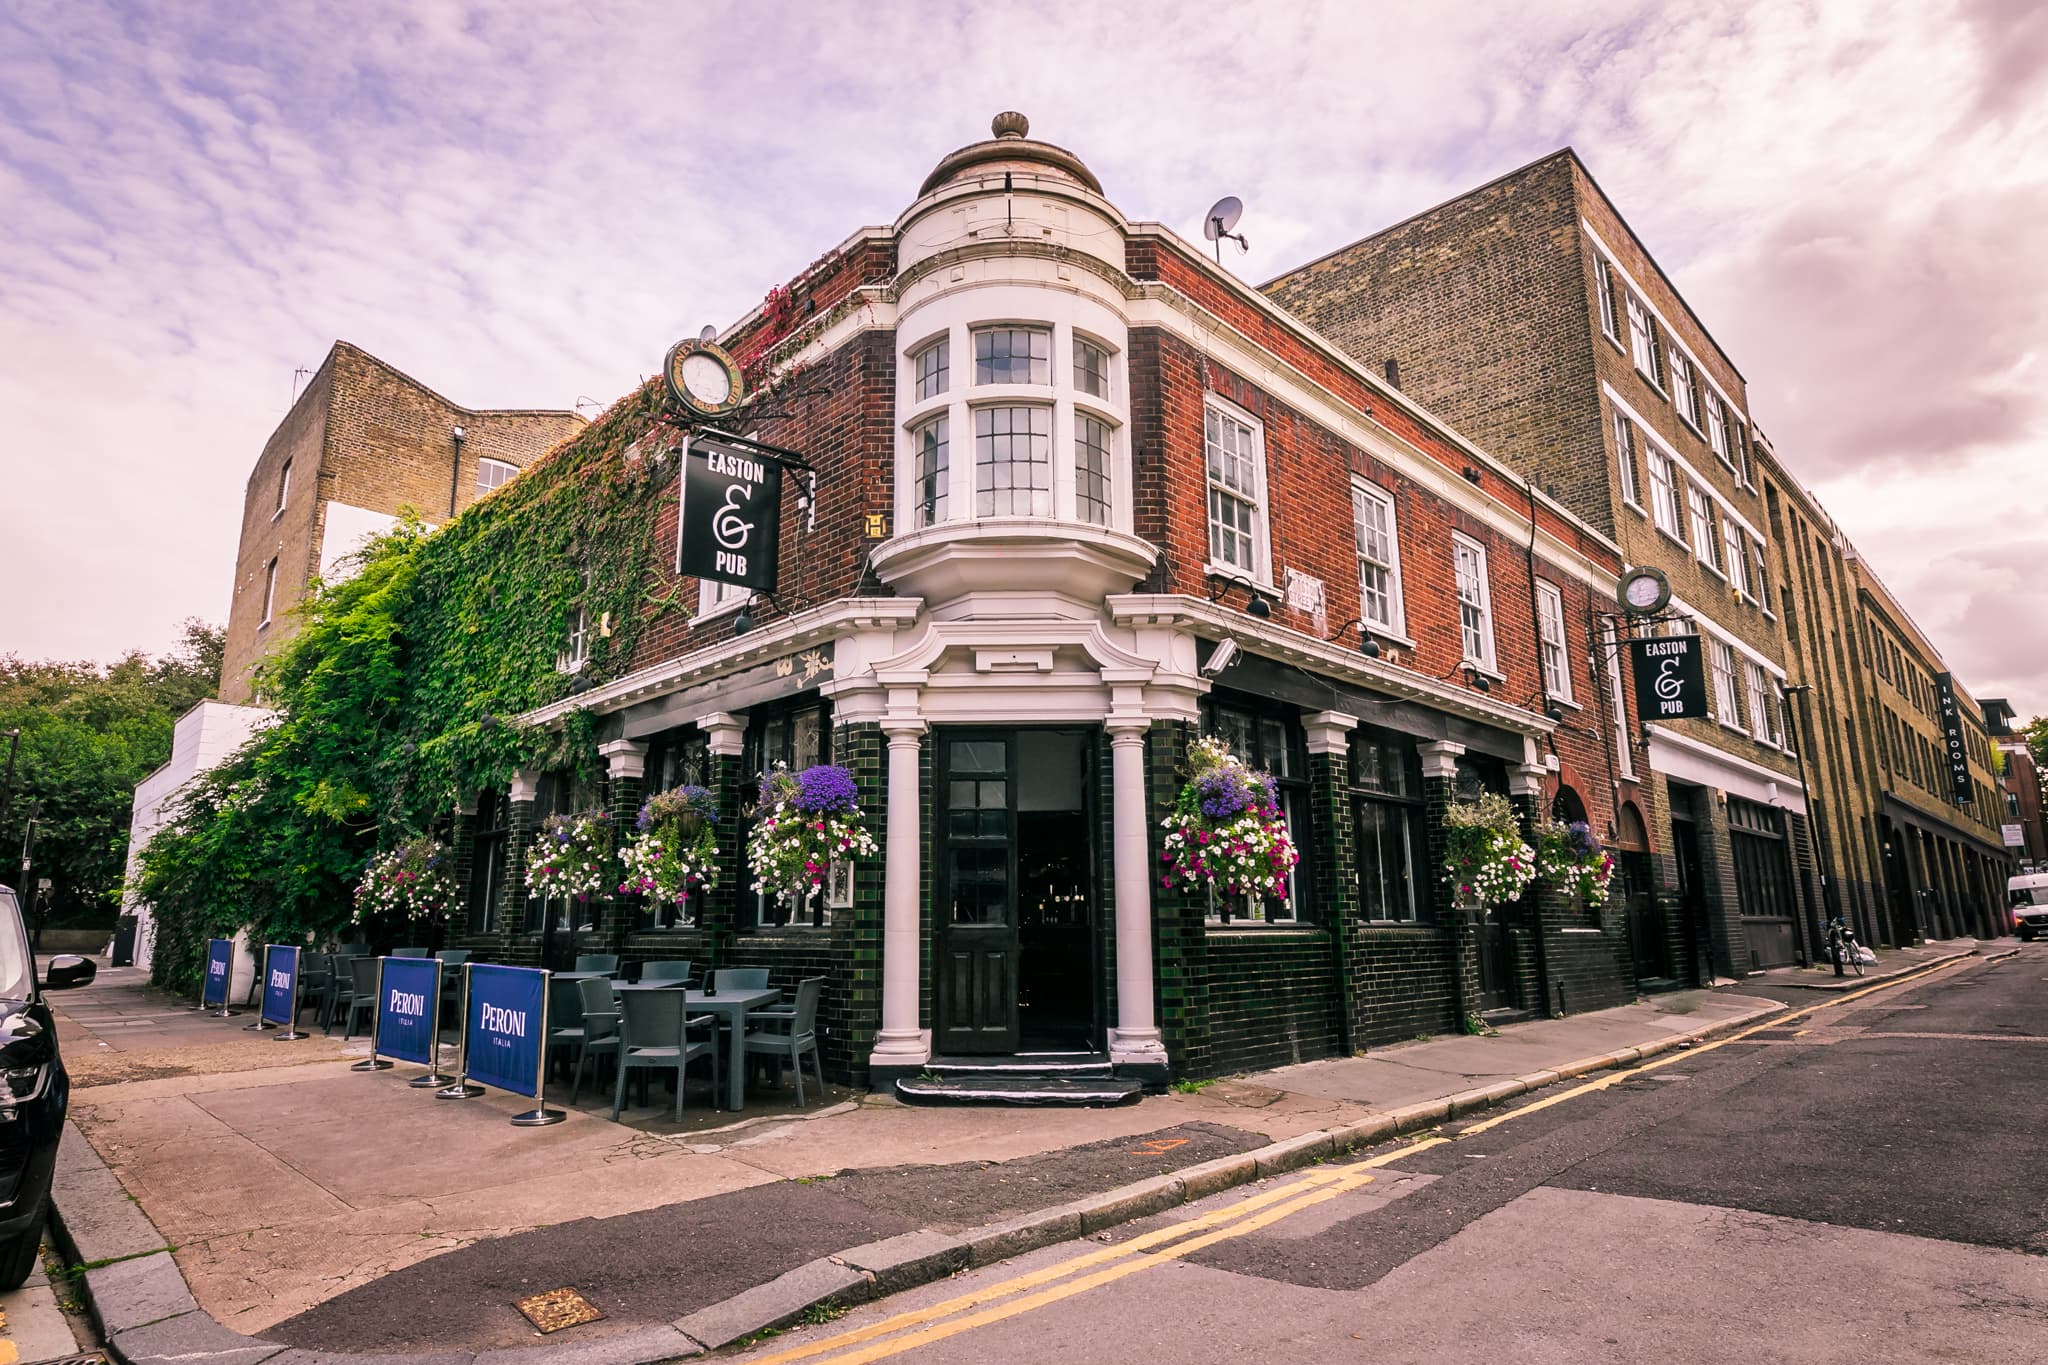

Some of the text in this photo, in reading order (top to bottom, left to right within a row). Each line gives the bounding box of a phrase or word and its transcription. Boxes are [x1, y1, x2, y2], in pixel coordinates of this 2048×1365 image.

[707, 450, 764, 484] EASTON
[713, 484, 755, 549] &
[715, 550, 748, 577] PUB
[1645, 641, 1688, 657] EASTON
[1655, 656, 1685, 699] &
[1660, 700, 1684, 714] PUB
[1942, 686, 1966, 784] INK ROOMS
[210, 958, 227, 976] PERONI
[270, 968, 291, 990] PERONI
[389, 989, 425, 1017] PERONI
[480, 1002, 527, 1038] PERONI
[493, 1037, 512, 1049] ITALIA
